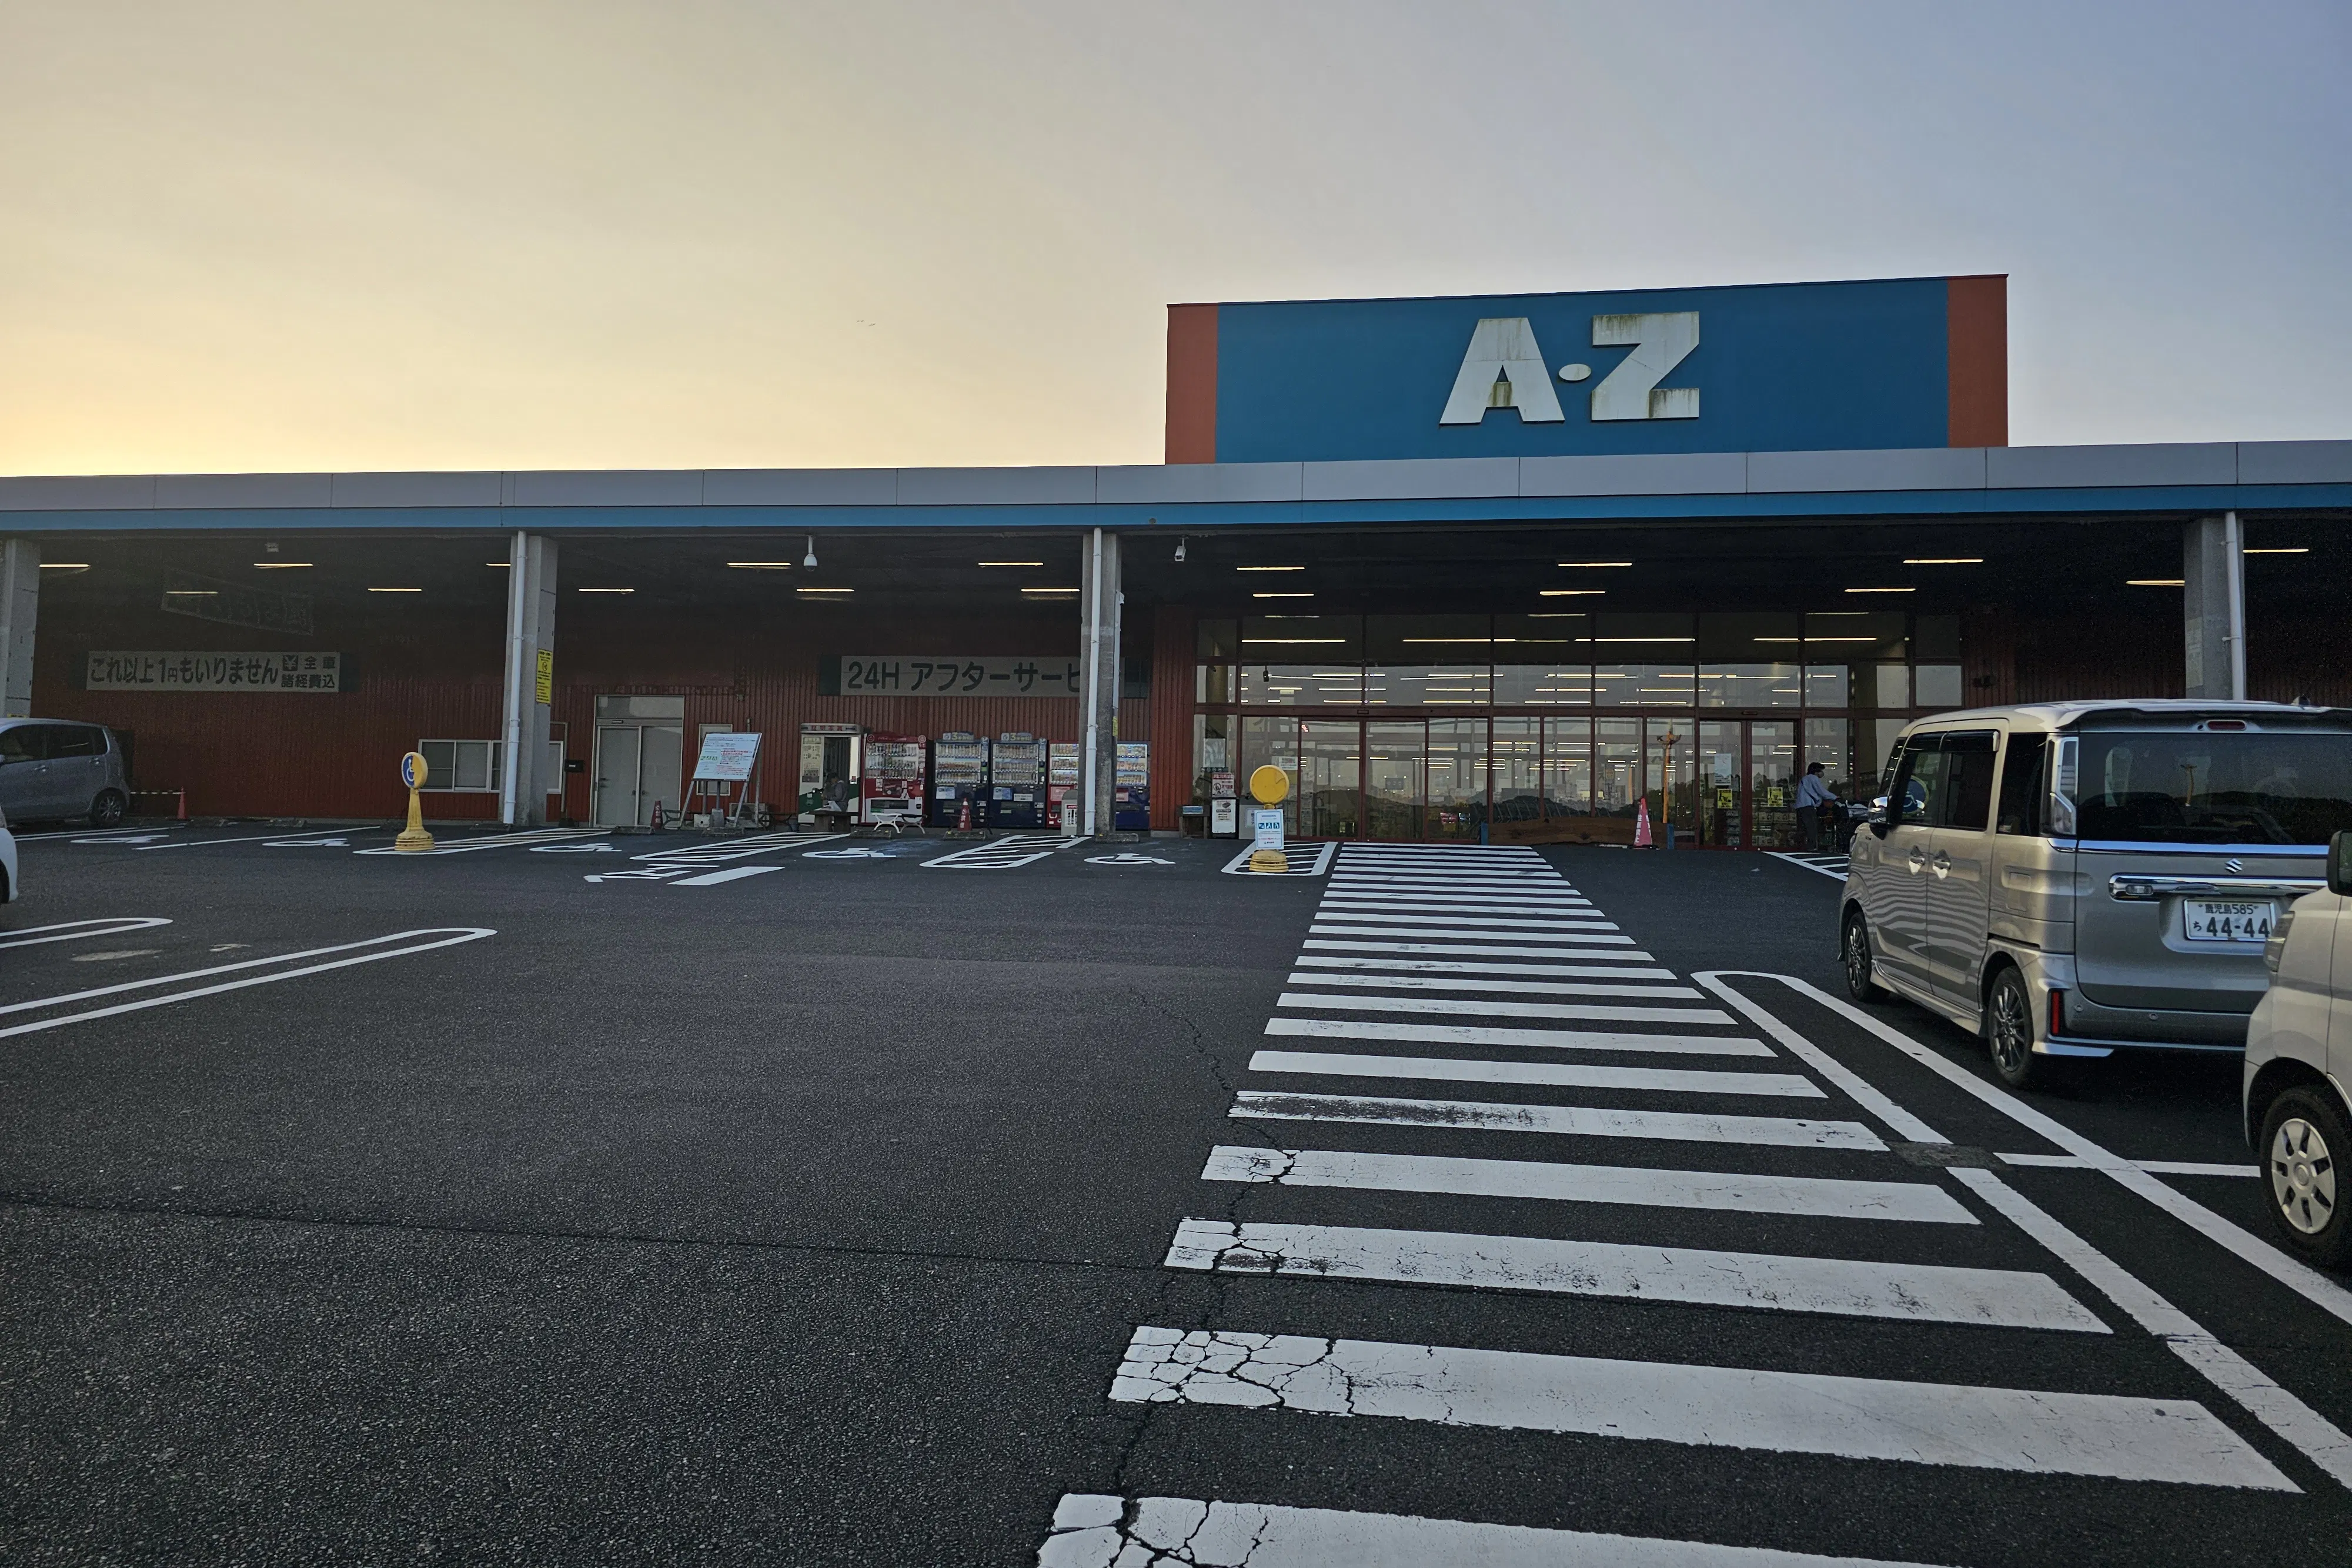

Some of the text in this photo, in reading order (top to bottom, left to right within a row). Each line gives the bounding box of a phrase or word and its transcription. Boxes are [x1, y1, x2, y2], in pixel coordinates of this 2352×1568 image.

[91, 656, 279, 684] これ以上1円もいりません
[847, 661, 900, 690] 24H
[2193, 921, 2202, 931] ち
